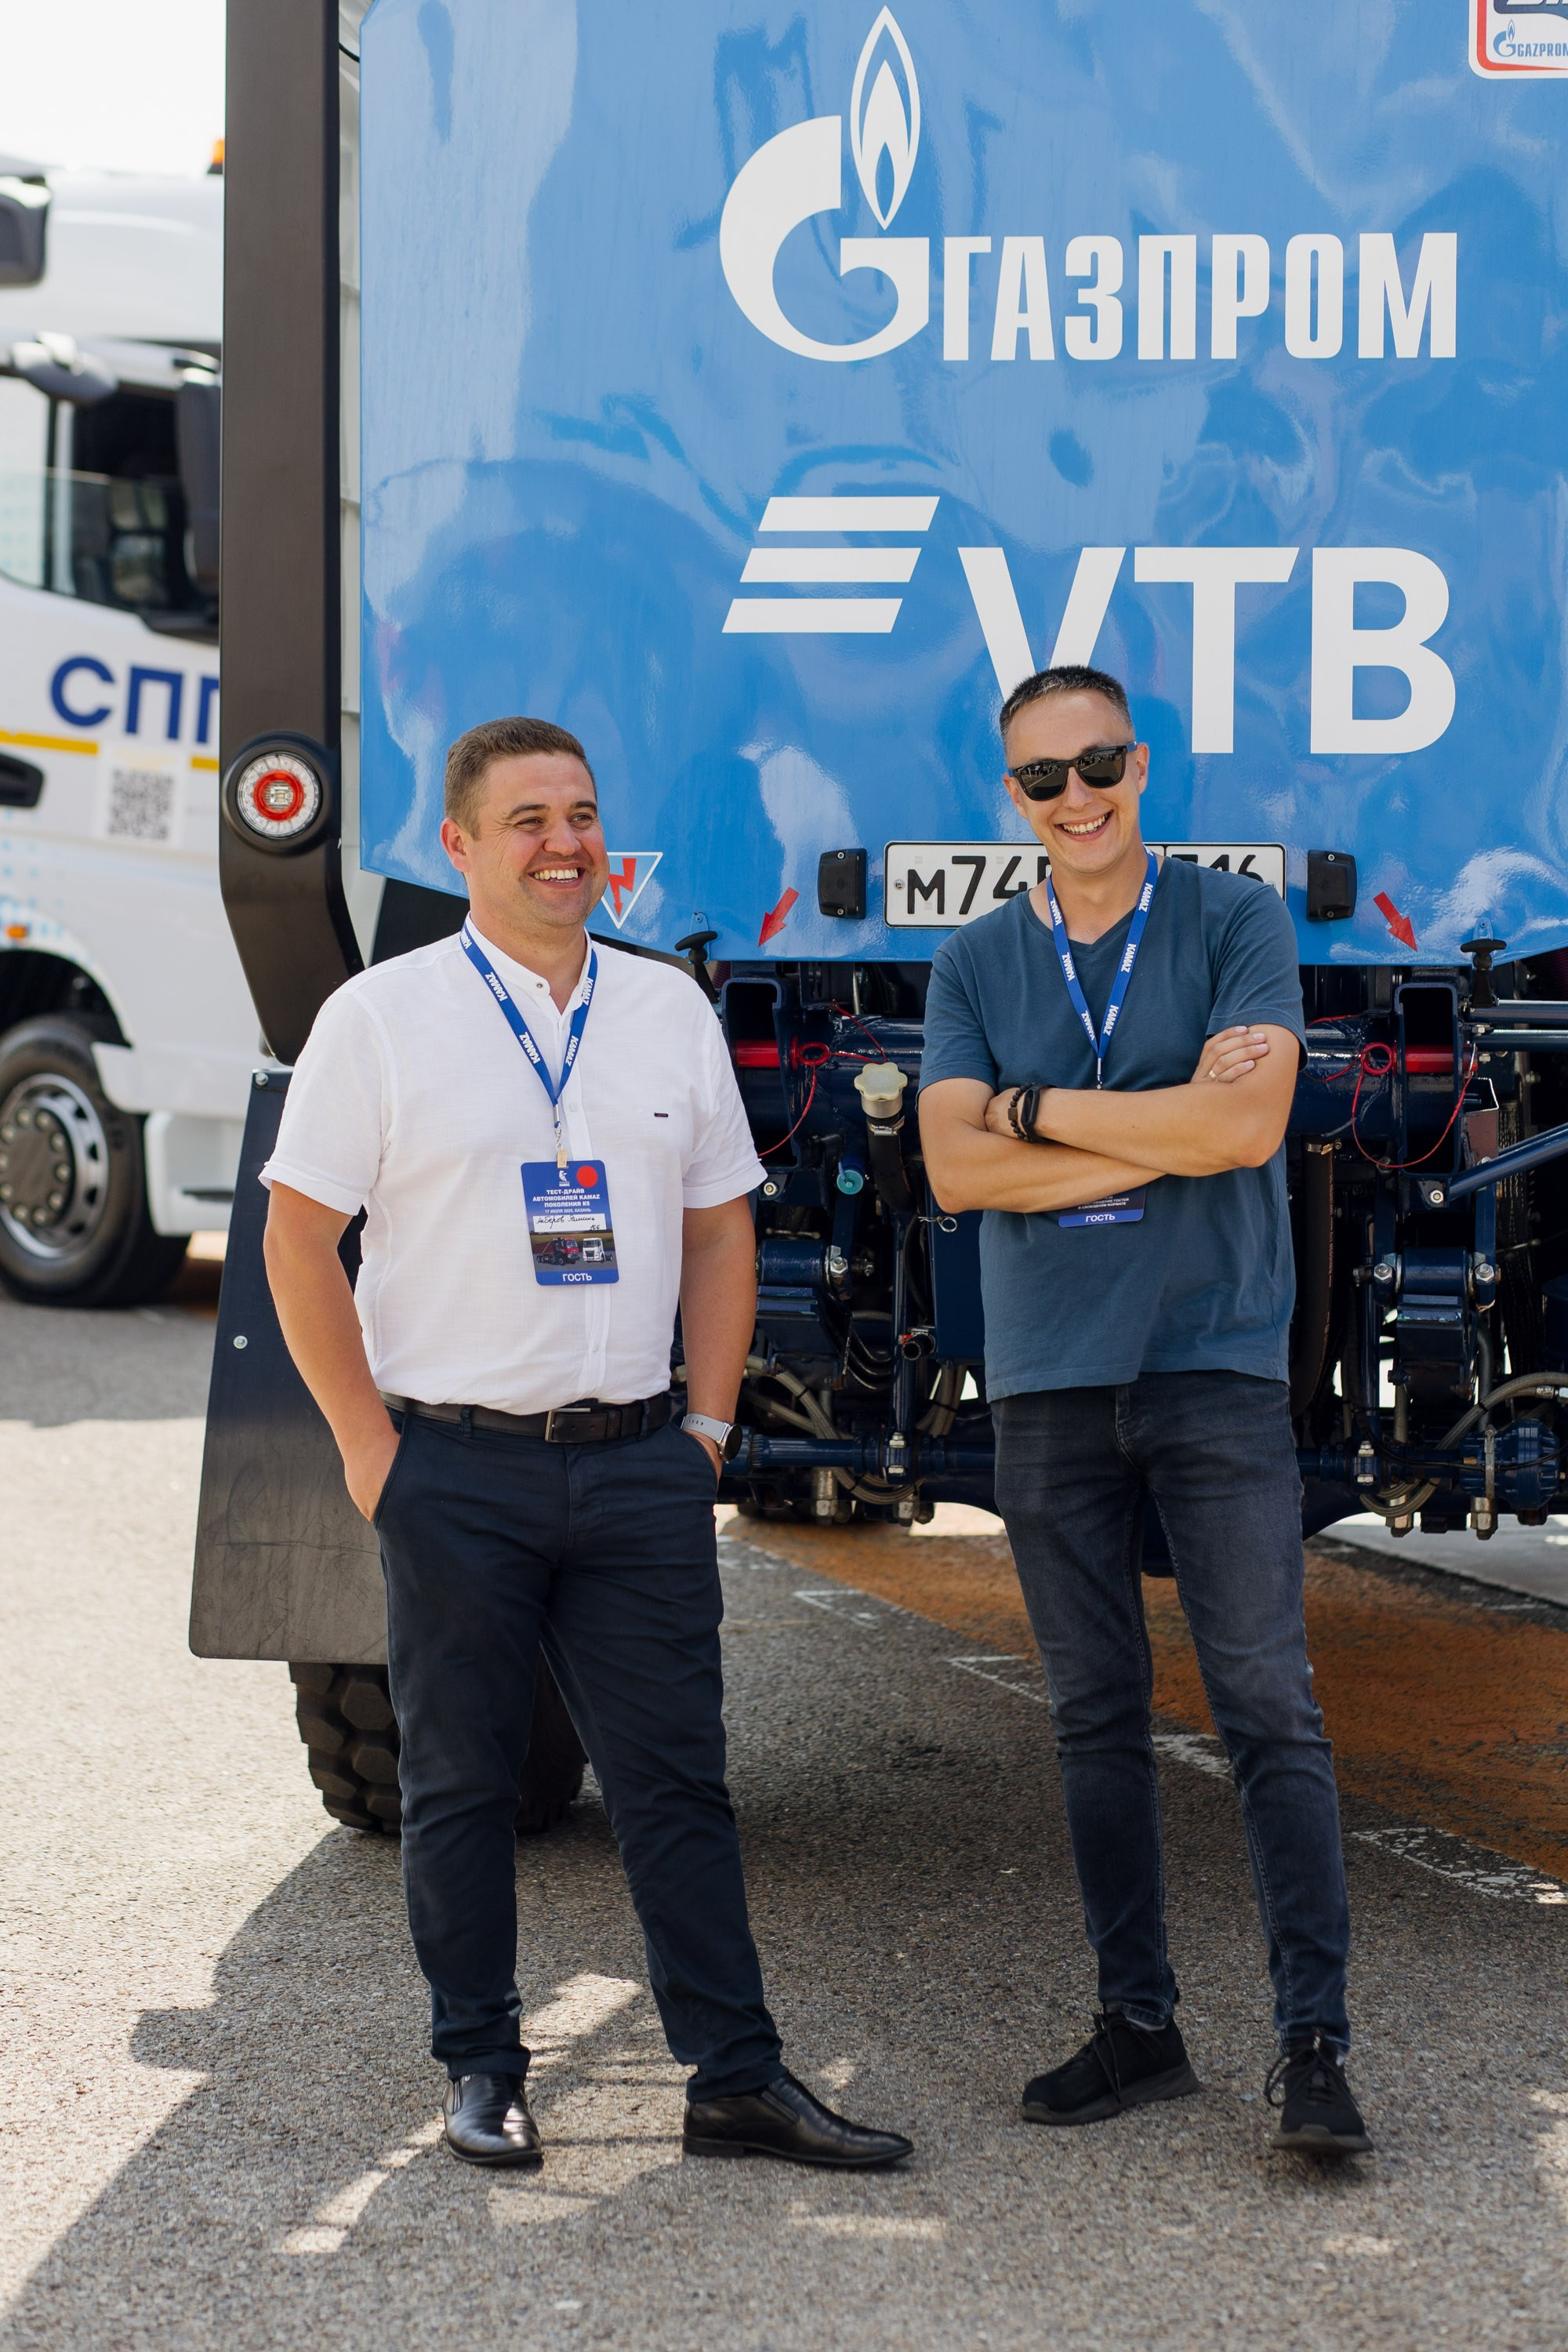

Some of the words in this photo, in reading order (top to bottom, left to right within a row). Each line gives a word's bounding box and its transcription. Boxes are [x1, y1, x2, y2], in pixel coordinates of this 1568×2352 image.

[943, 232, 1457, 361] ГАЗПРОМ
[957, 546, 1456, 754] VTB
[1050, 897, 1062, 926] KAMAZ
[1138, 882, 1153, 913] KAMAZ
[1062, 952, 1075, 982] KAMAZ
[1121, 943, 1136, 973] KAMAZ
[485, 971, 507, 1002] KAMAZ
[581, 977, 593, 1006] KAMAZ
[1080, 1010, 1095, 1041] KAMAZ
[1103, 1004, 1119, 1036] KAMAZ
[519, 1032, 541, 1064] KAMAZ
[564, 1035, 579, 1066] KAMAZ
[1085, 1214, 1116, 1222] ГОСТЬ
[562, 1272, 593, 1282] ГОСТЬ
